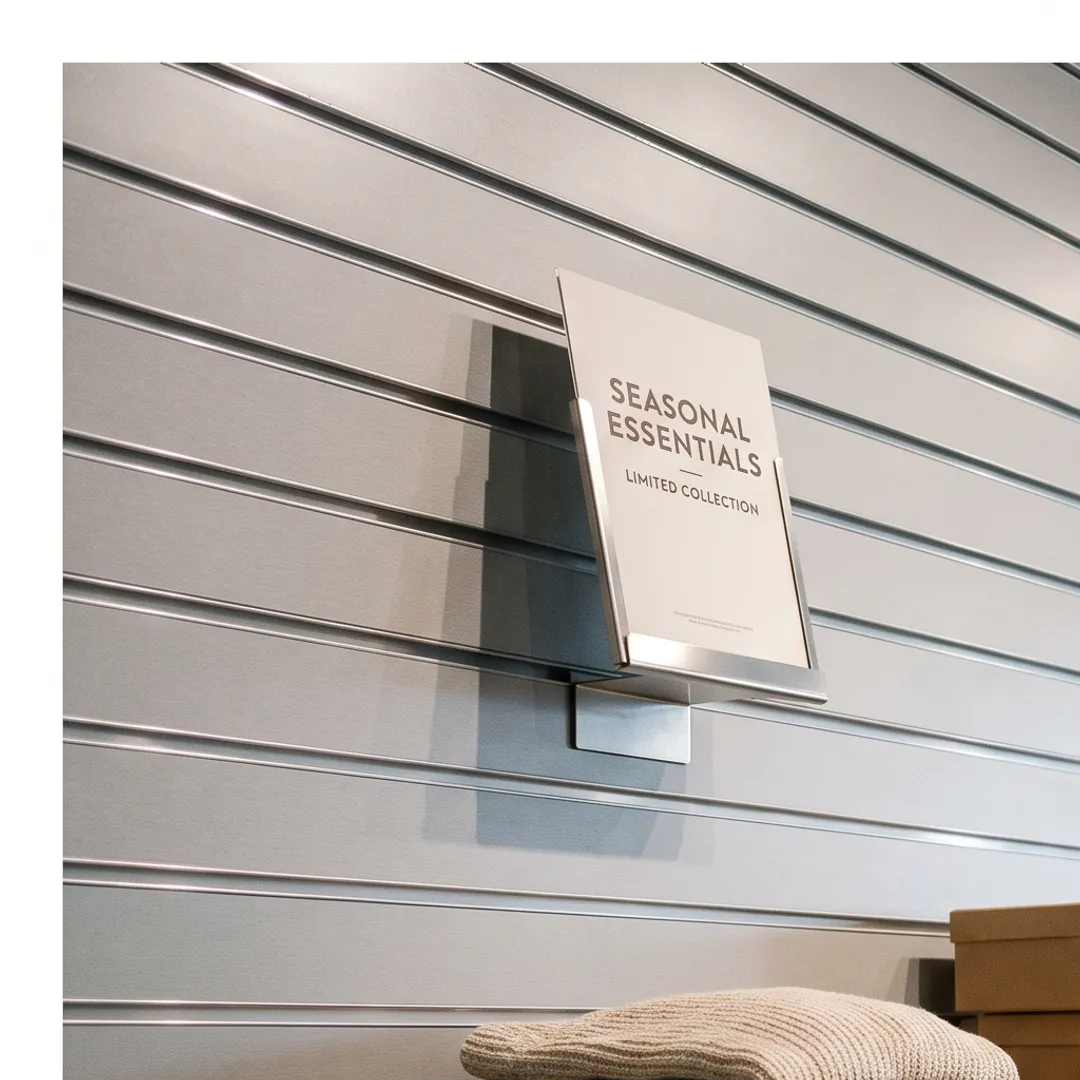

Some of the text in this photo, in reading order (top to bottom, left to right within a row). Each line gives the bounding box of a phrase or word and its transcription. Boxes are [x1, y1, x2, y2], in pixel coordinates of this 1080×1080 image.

[609, 377, 751, 443] SEASONAL
[607, 410, 762, 477] ESSENTIALS
[625, 469, 760, 516] LIMITED COLLECTION
